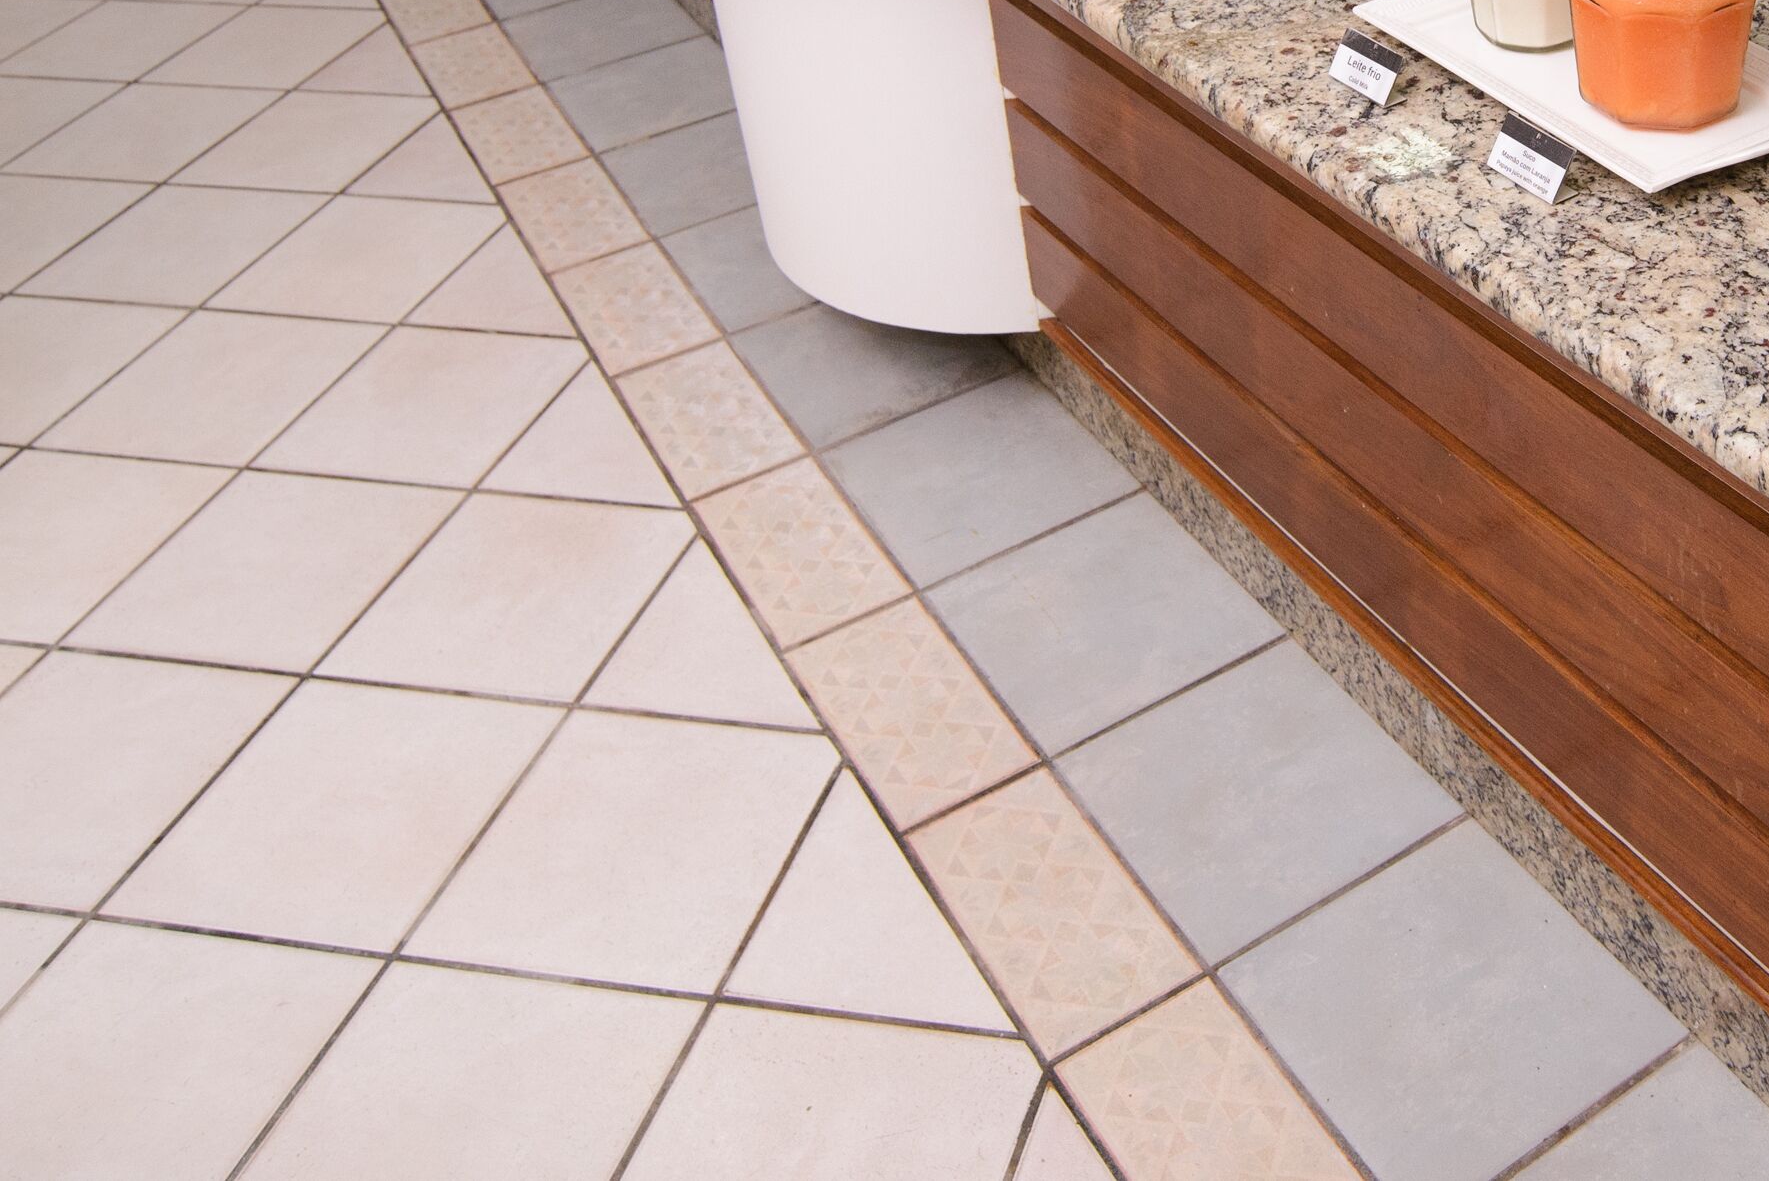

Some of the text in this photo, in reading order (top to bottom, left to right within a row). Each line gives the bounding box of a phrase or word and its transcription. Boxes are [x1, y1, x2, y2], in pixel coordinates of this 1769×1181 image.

[1347, 55, 1381, 81] Leite frio
[1501, 149, 1551, 185] Mamão com Laranja
[1522, 149, 1536, 163] Suco
